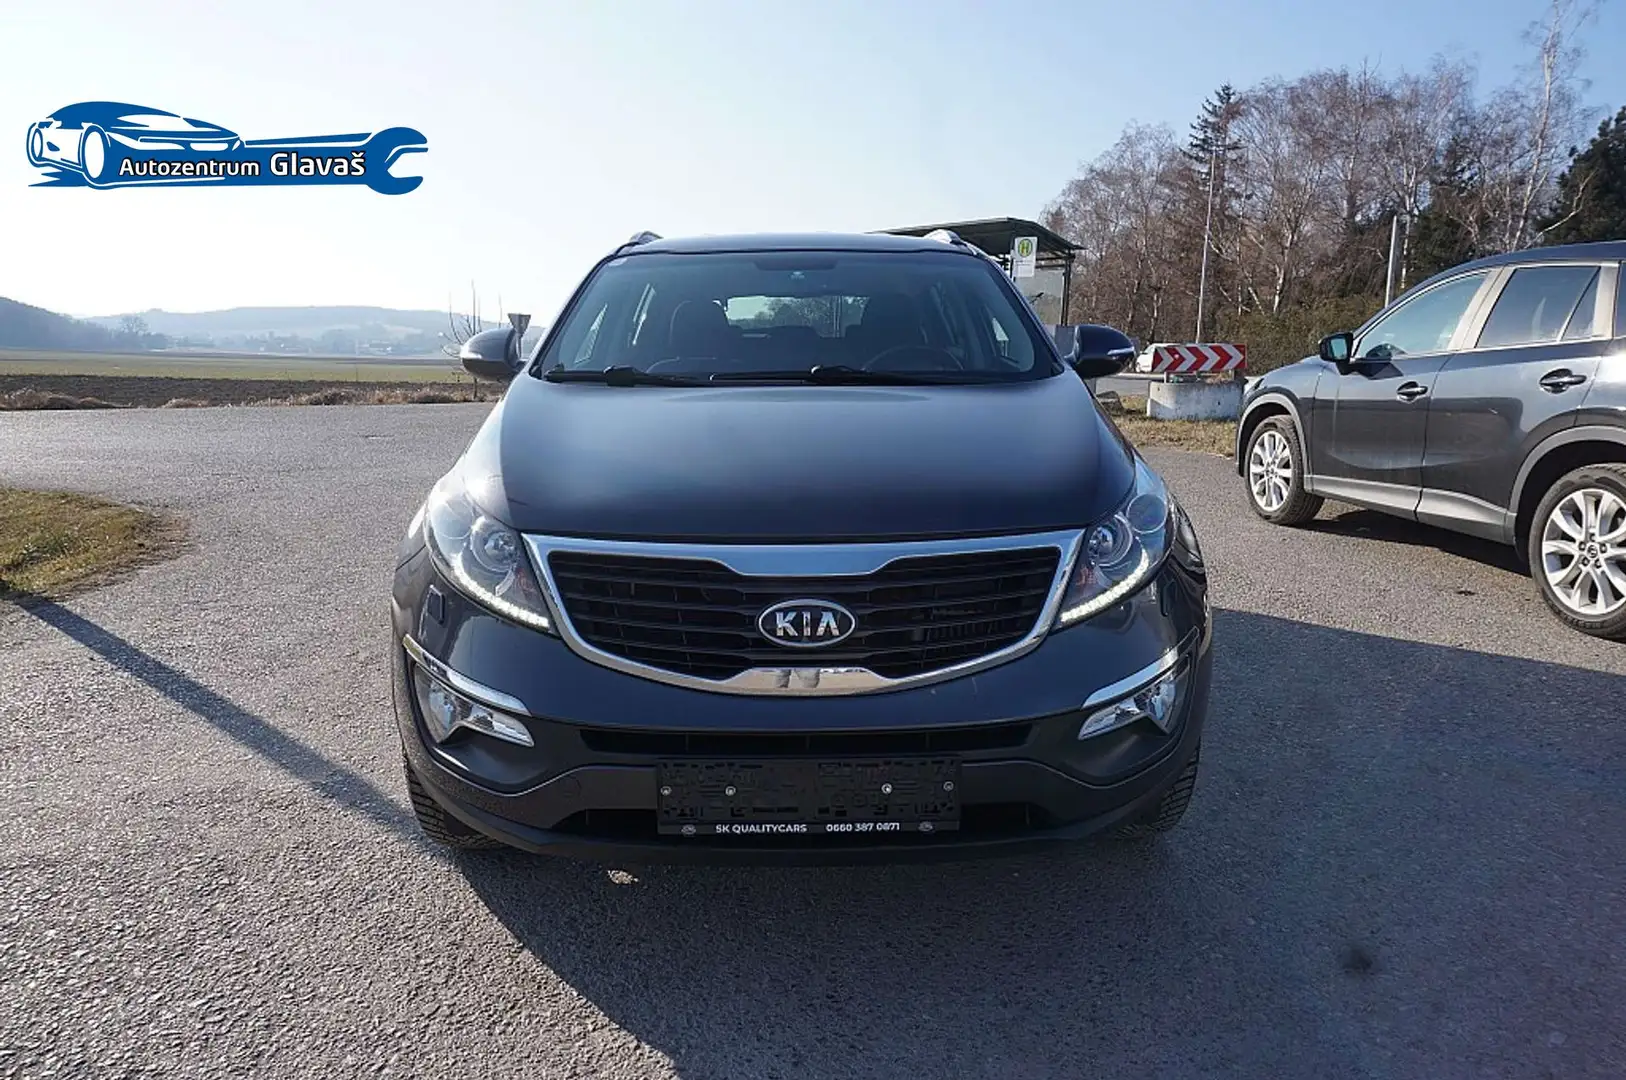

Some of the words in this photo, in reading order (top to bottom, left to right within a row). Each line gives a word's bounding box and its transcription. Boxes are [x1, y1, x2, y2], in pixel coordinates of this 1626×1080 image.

[775, 611, 840, 636] KIA
[715, 823, 730, 834] SK
[731, 823, 808, 835] QUALITYCARS
[825, 823, 853, 832] 0660
